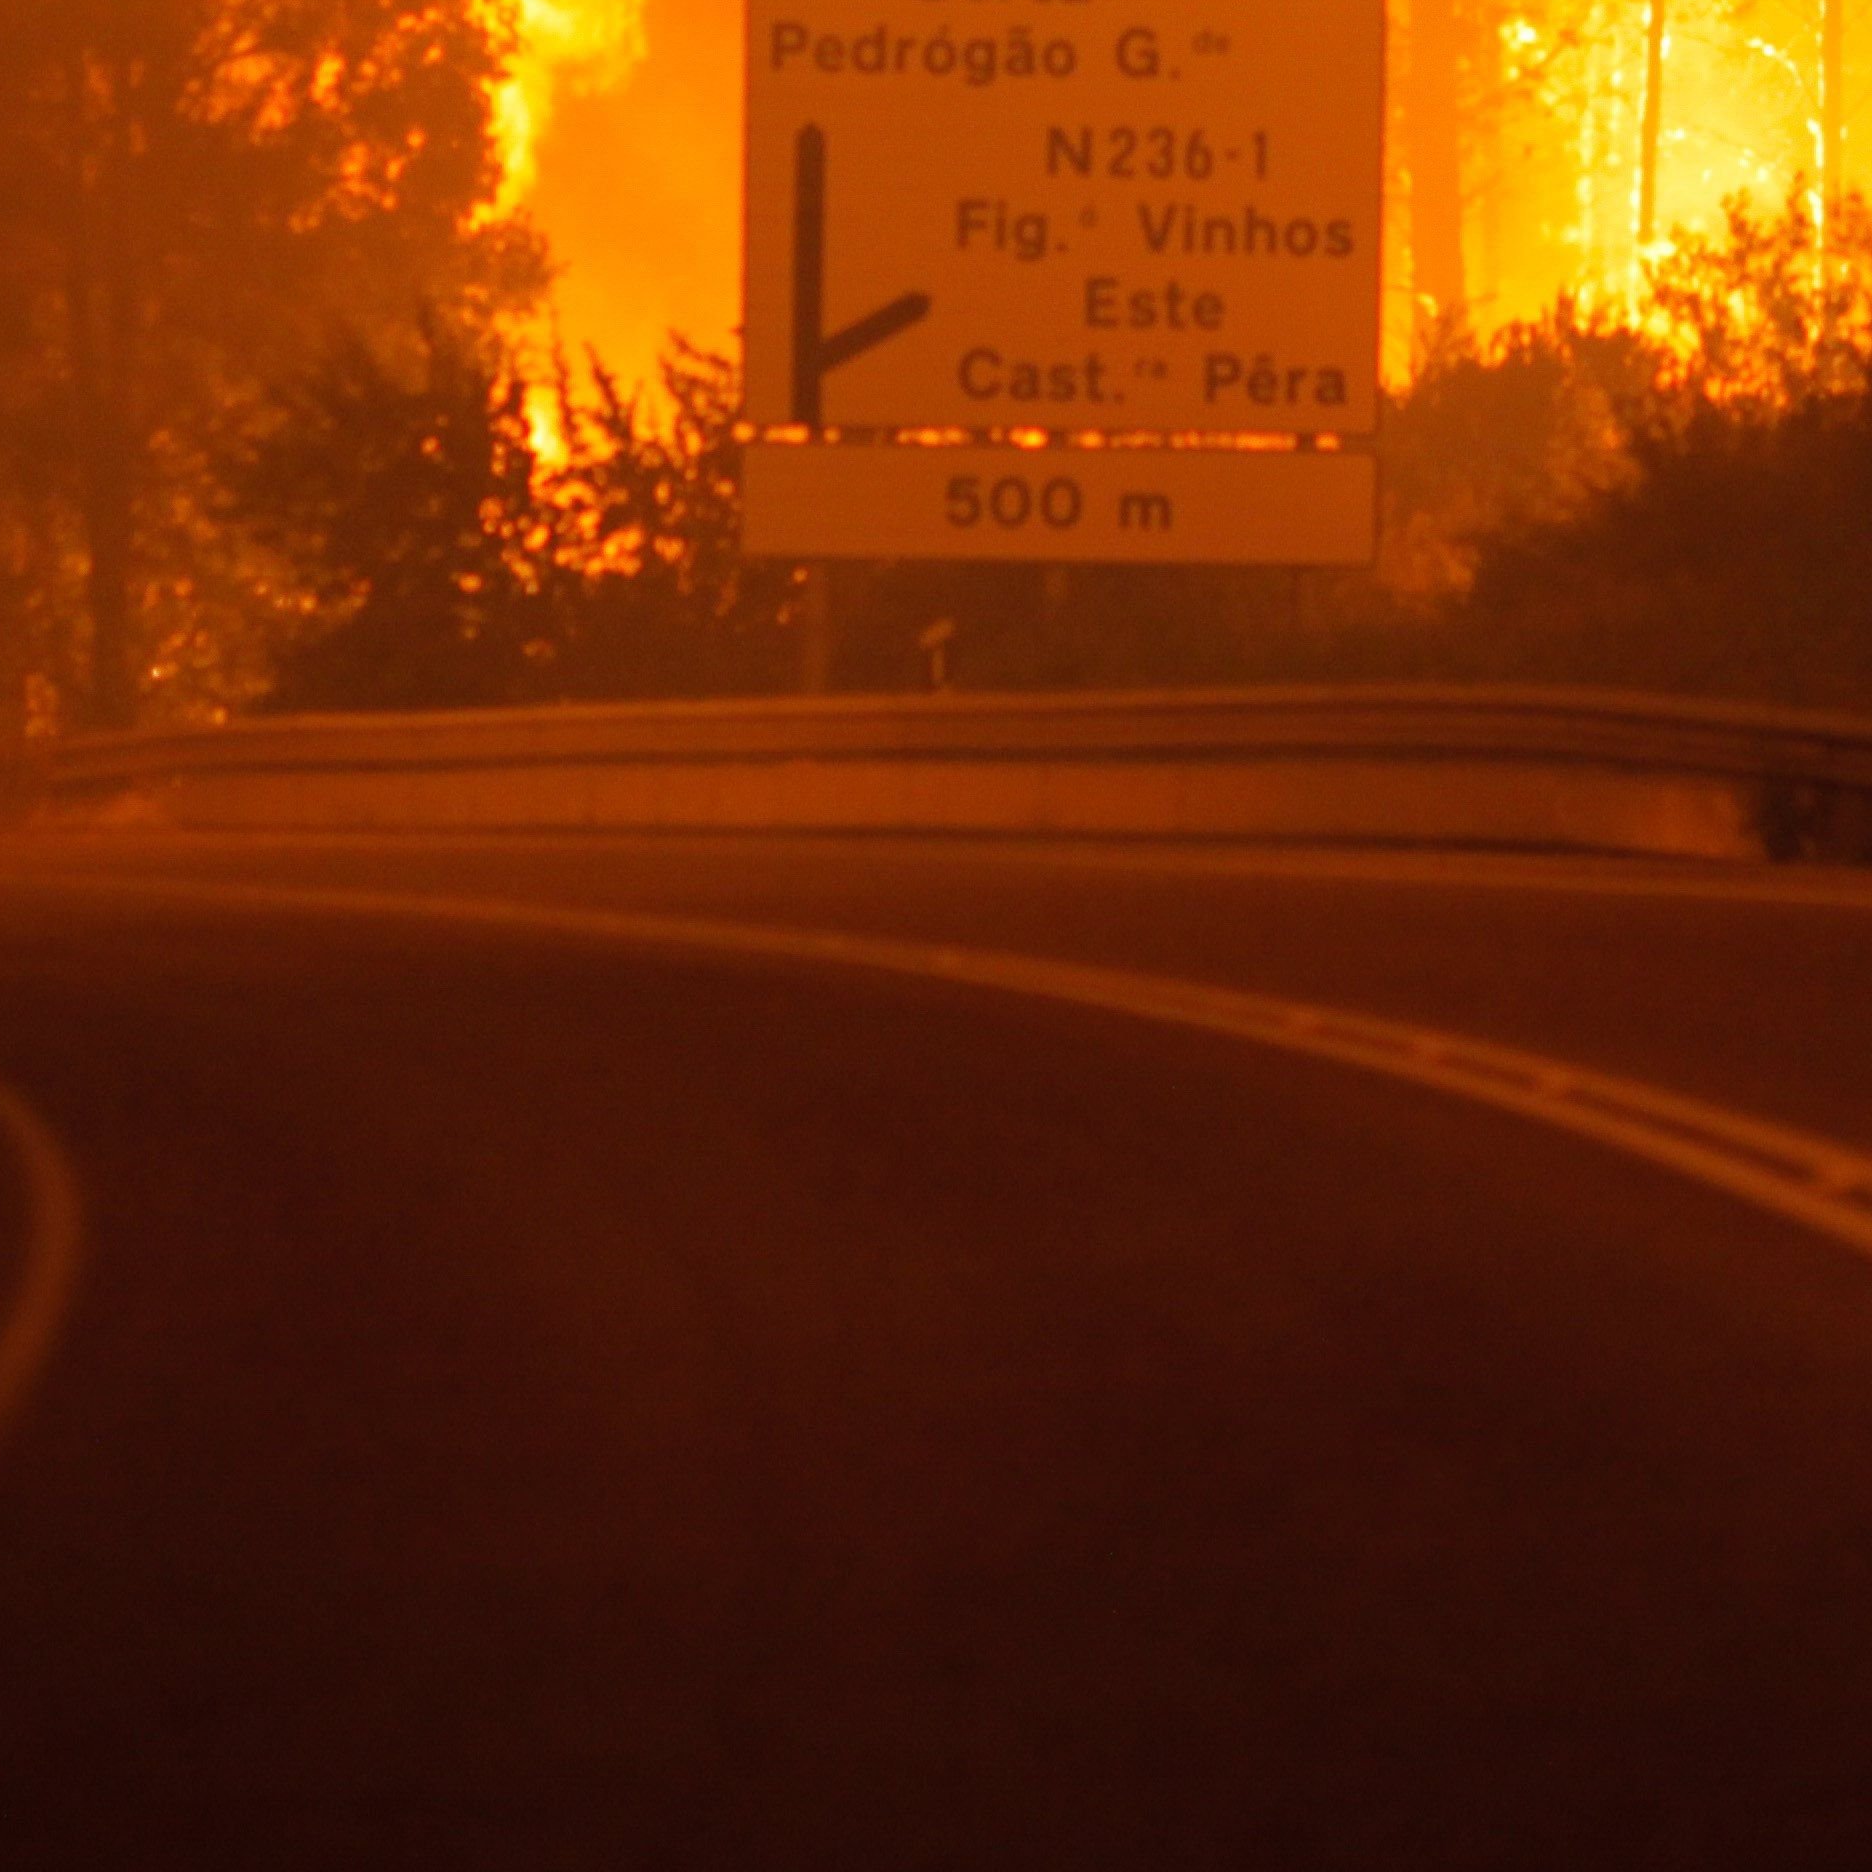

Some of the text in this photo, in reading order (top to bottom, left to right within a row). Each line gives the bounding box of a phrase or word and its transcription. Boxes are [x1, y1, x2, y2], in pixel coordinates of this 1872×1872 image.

[771, 21, 1078, 87] Pedrógão
[1136, 201, 1357, 258] Vinhos
[1083, 277, 1226, 330] Este
[1203, 352, 1349, 406] Pêra
[945, 476, 1173, 530] 500 m
